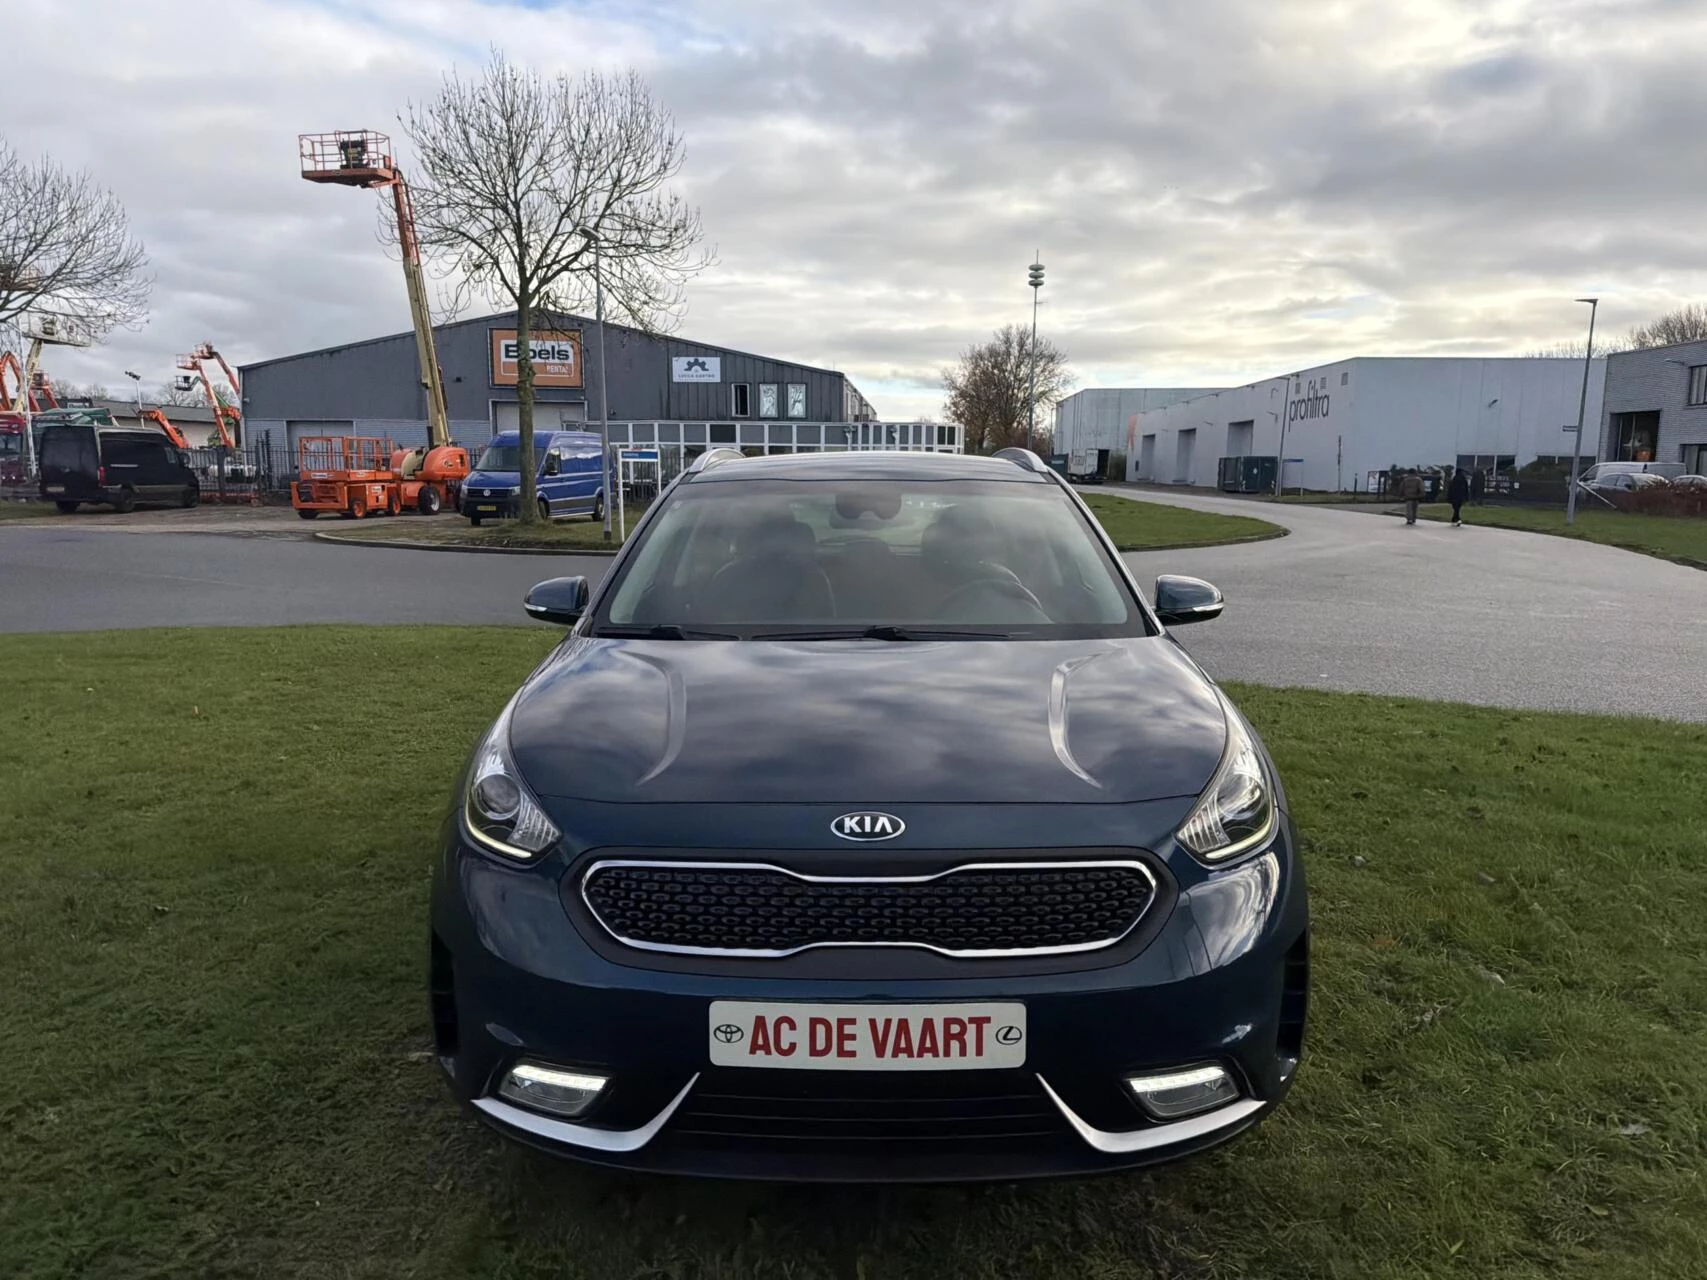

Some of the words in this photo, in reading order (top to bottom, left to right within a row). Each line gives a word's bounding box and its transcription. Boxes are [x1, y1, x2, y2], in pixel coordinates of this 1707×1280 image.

[1288, 379, 1330, 433] profiltra
[843, 815, 893, 834] KIA
[748, 1015, 798, 1057] AC
[808, 1016, 858, 1058] DE
[868, 1016, 992, 1058] VAART
